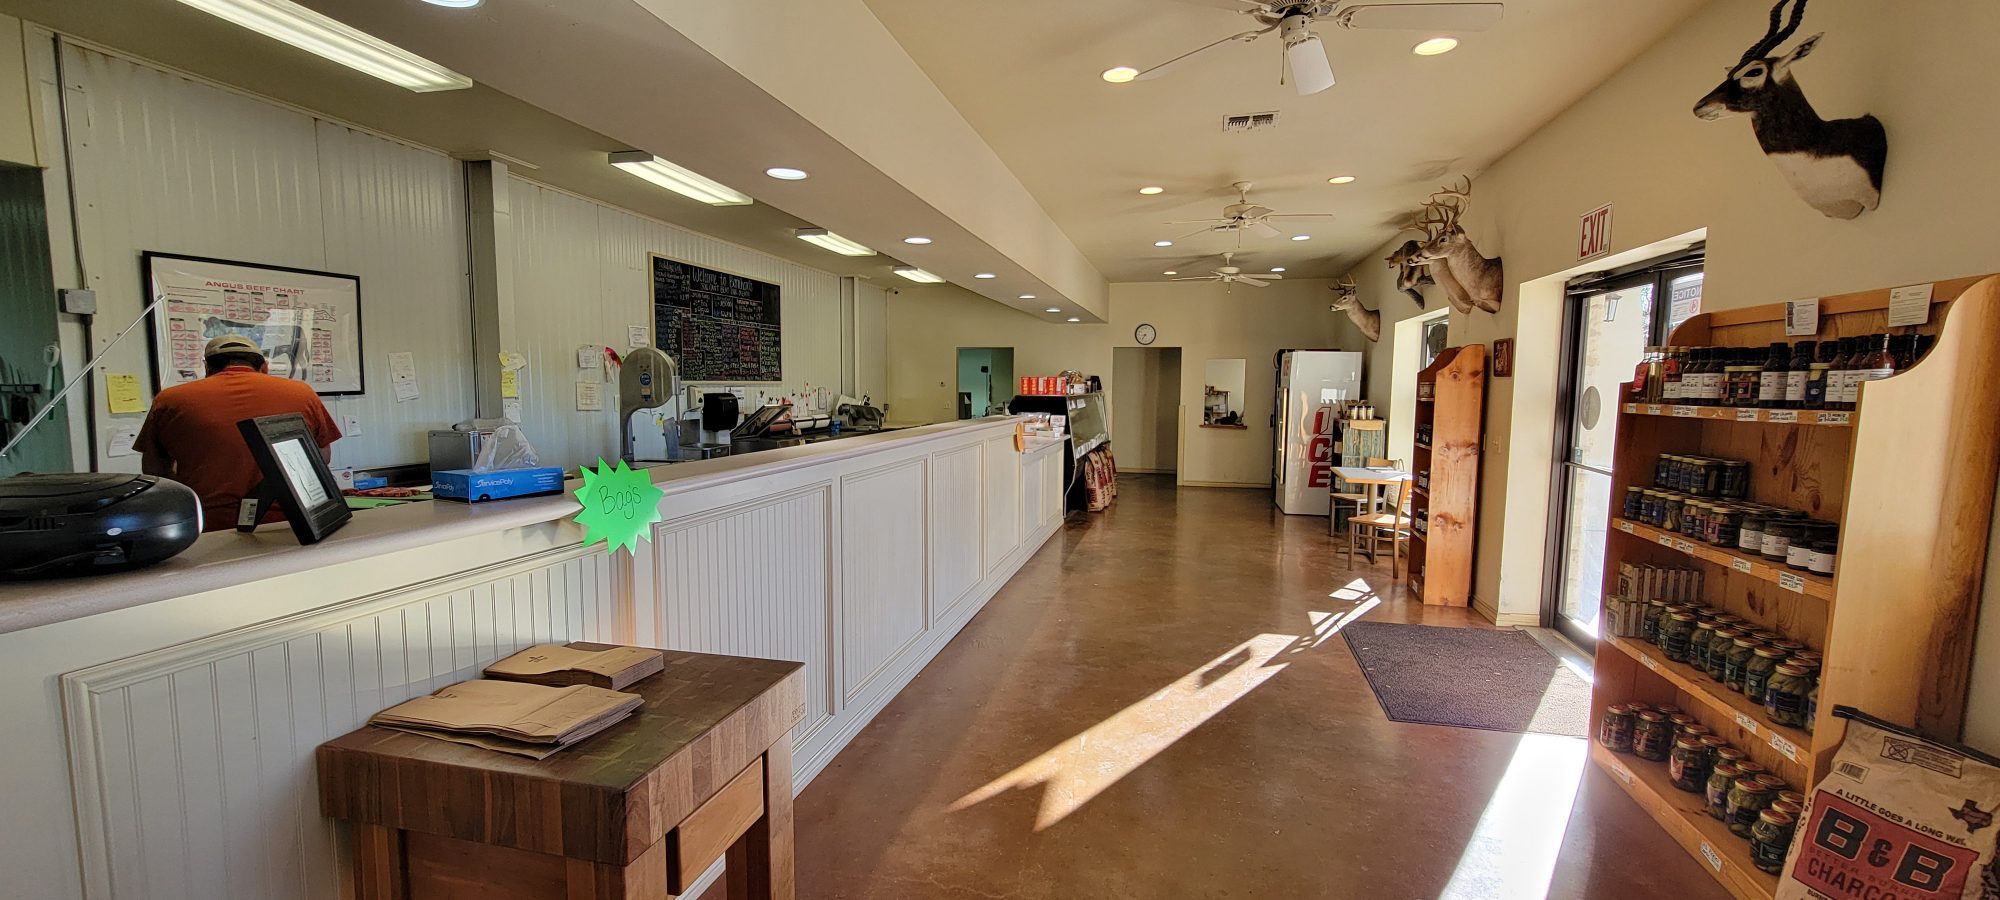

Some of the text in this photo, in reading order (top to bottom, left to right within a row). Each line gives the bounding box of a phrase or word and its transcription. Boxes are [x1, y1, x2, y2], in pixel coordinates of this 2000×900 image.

[1580, 208, 1609, 257] EXIT
[205, 281, 244, 290] ANGUS
[273, 287, 305, 295] CHART
[1307, 406, 1332, 488] ICE
[474, 477, 515, 489] ServicePoly
[1835, 788, 1844, 796] A
[1845, 791, 1877, 811] LITTLE
[1878, 806, 1904, 822] GOES
[1905, 818, 1913, 827] A
[1914, 822, 1944, 839] LONG
[1813, 805, 1871, 860] B
[1867, 838, 1893, 868] &
[1890, 841, 1957, 893] B
